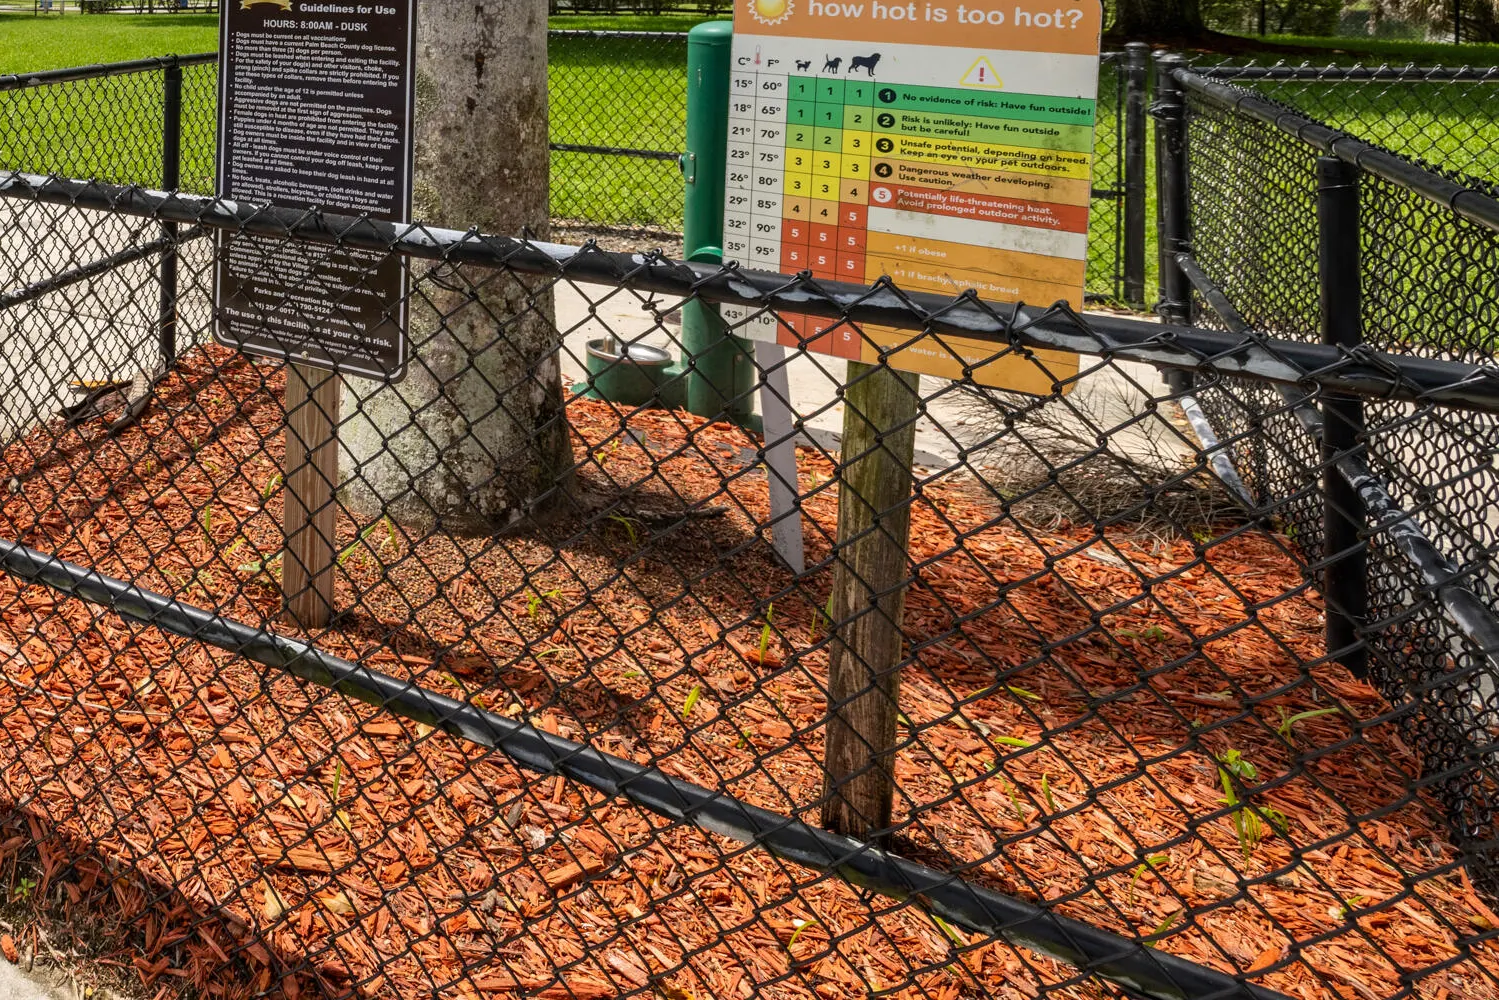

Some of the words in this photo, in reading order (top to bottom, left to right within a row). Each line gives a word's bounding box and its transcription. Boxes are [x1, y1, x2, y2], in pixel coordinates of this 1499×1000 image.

[300, 3, 354, 13] Guidelines
[357, 5, 372, 14] for
[375, 6, 396, 14] Use
[872, 1, 917, 21] hot
[925, 3, 948, 22] is
[957, 5, 1005, 25] too
[1015, 7, 1083, 29] hot?
[264, 19, 298, 28] HOURS:
[301, 21, 333, 30] 8:00AM
[341, 22, 367, 31] DUSK
[799, 84, 804, 93] 1
[827, 87, 833, 95] 1
[856, 89, 862, 98] 1
[885, 92, 890, 100] 1
[919, 95, 961, 105] evidence
[964, 98, 975, 106] of
[977, 100, 997, 108] risk:
[1001, 102, 1026, 110] Have
[1029, 104, 1045, 112] fun
[1049, 105, 1091, 115] outside!
[798, 109, 803, 118] 1
[826, 112, 831, 120] 1
[854, 114, 861, 123] 2
[882, 116, 890, 126] 2
[902, 115, 920, 123] Risk
[933, 118, 972, 130] unlikely:
[975, 122, 1000, 130] Have
[1003, 124, 1019, 132] fun
[1022, 126, 1060, 136] outside
[920, 125, 931, 133] be
[934, 127, 969, 136] careful!
[796, 133, 803, 142] 2
[824, 136, 831, 145] 2
[853, 139, 860, 148] 3
[881, 141, 889, 150] 3
[901, 139, 932, 150] Unsafe
[934, 143, 980, 155] potential,
[984, 148, 1037, 162] depending
[1056, 155, 1089, 165] breed.
[795, 157, 802, 166] 3
[823, 160, 830, 169] 3
[852, 163, 859, 172] 3
[900, 148, 924, 158] Keep
[976, 155, 999, 167] your
[1001, 159, 1017, 168] pet
[1021, 160, 1070, 172] outdoors.
[880, 166, 887, 175] 4
[899, 164, 950, 179] Dangerous
[952, 170, 991, 181] weather
[994, 175, 1053, 190] developing.
[899, 174, 916, 182] Use
[919, 175, 955, 186] caution.
[794, 181, 801, 190] 3
[822, 184, 829, 193] 3
[850, 188, 858, 197] 4
[879, 191, 886, 200] 5
[898, 189, 947, 204] Potentially
[950, 195, 1024, 213] life-threatening
[1027, 205, 1053, 215] heat.
[793, 205, 800, 213] 4
[821, 208, 828, 217] 4
[849, 212, 857, 221] 5
[897, 197, 925, 208] Avoid
[927, 201, 976, 216] prolonged
[978, 208, 1018, 220] outdoor
[1022, 213, 1060, 227] activity.
[792, 229, 799, 238] 5
[820, 232, 827, 242] 5
[848, 237, 855, 246] 5
[910, 246, 917, 254] if
[919, 247, 947, 258] obese
[791, 252, 798, 261] 5
[819, 256, 826, 265] 5
[847, 260, 854, 270] 5
[225, 307, 240, 317] The
[242, 311, 255, 320] use
[283, 318, 310, 332] facility
[322, 327, 331, 335] at
[332, 330, 351, 340] your
[353, 334, 371, 343] on
[373, 337, 392, 348] risk.
[843, 332, 851, 341] 5
